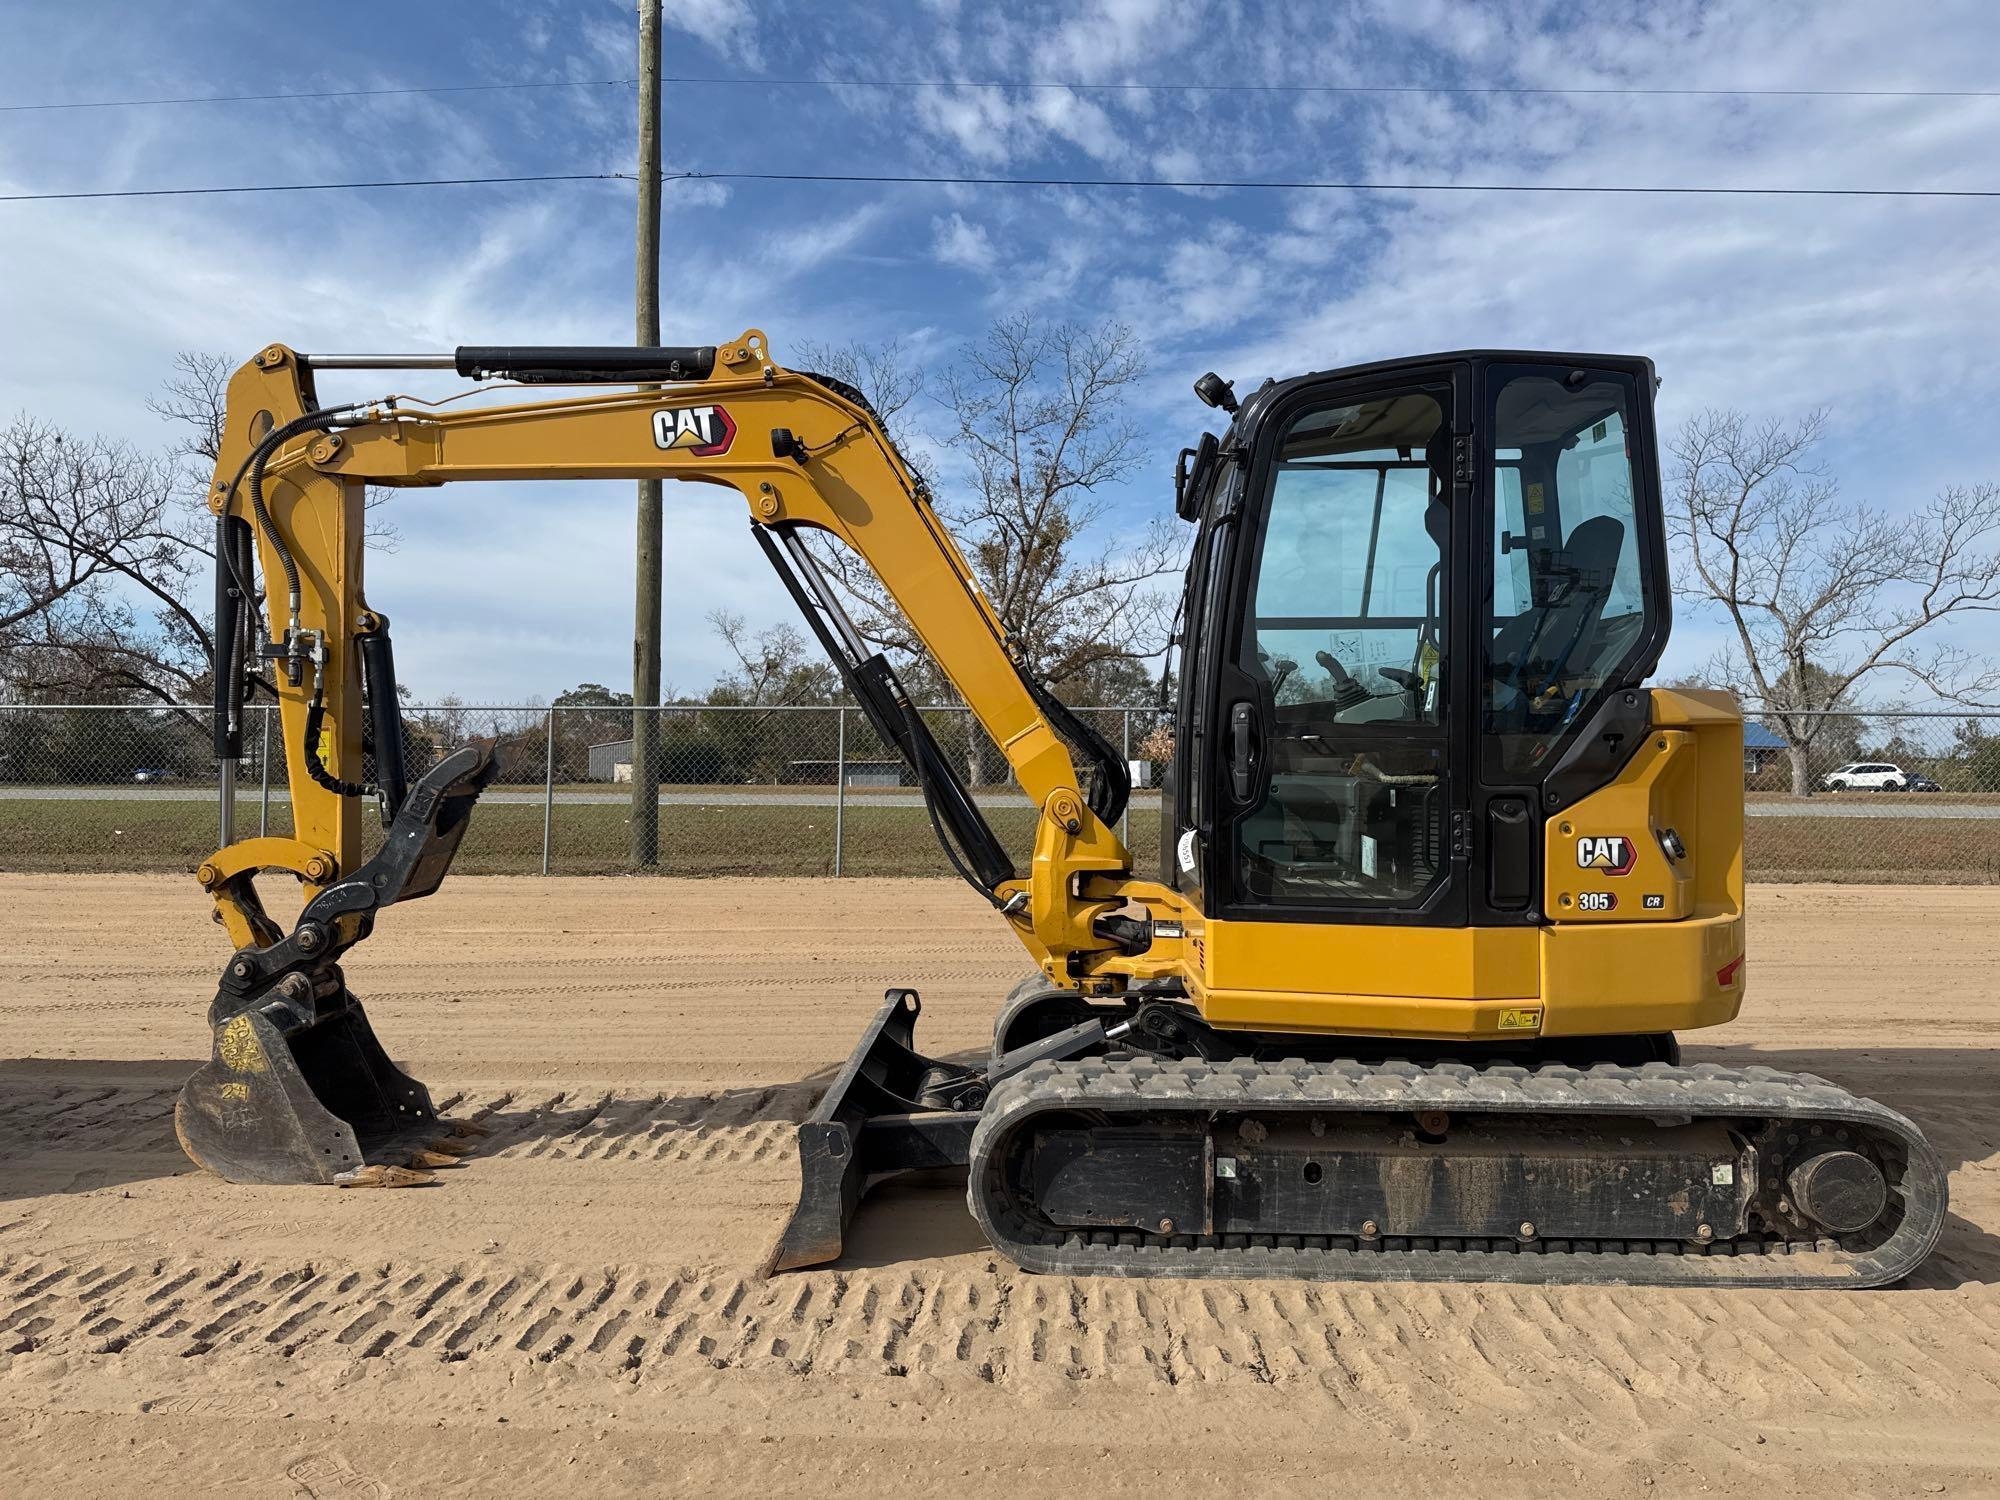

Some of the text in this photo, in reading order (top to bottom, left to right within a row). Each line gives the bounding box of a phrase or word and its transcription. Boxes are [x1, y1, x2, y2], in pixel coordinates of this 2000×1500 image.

[653, 406, 714, 449] CAT
[1577, 837, 1623, 867] CAT
[1579, 893, 1609, 910] 305
[1646, 896, 1661, 907] CR
